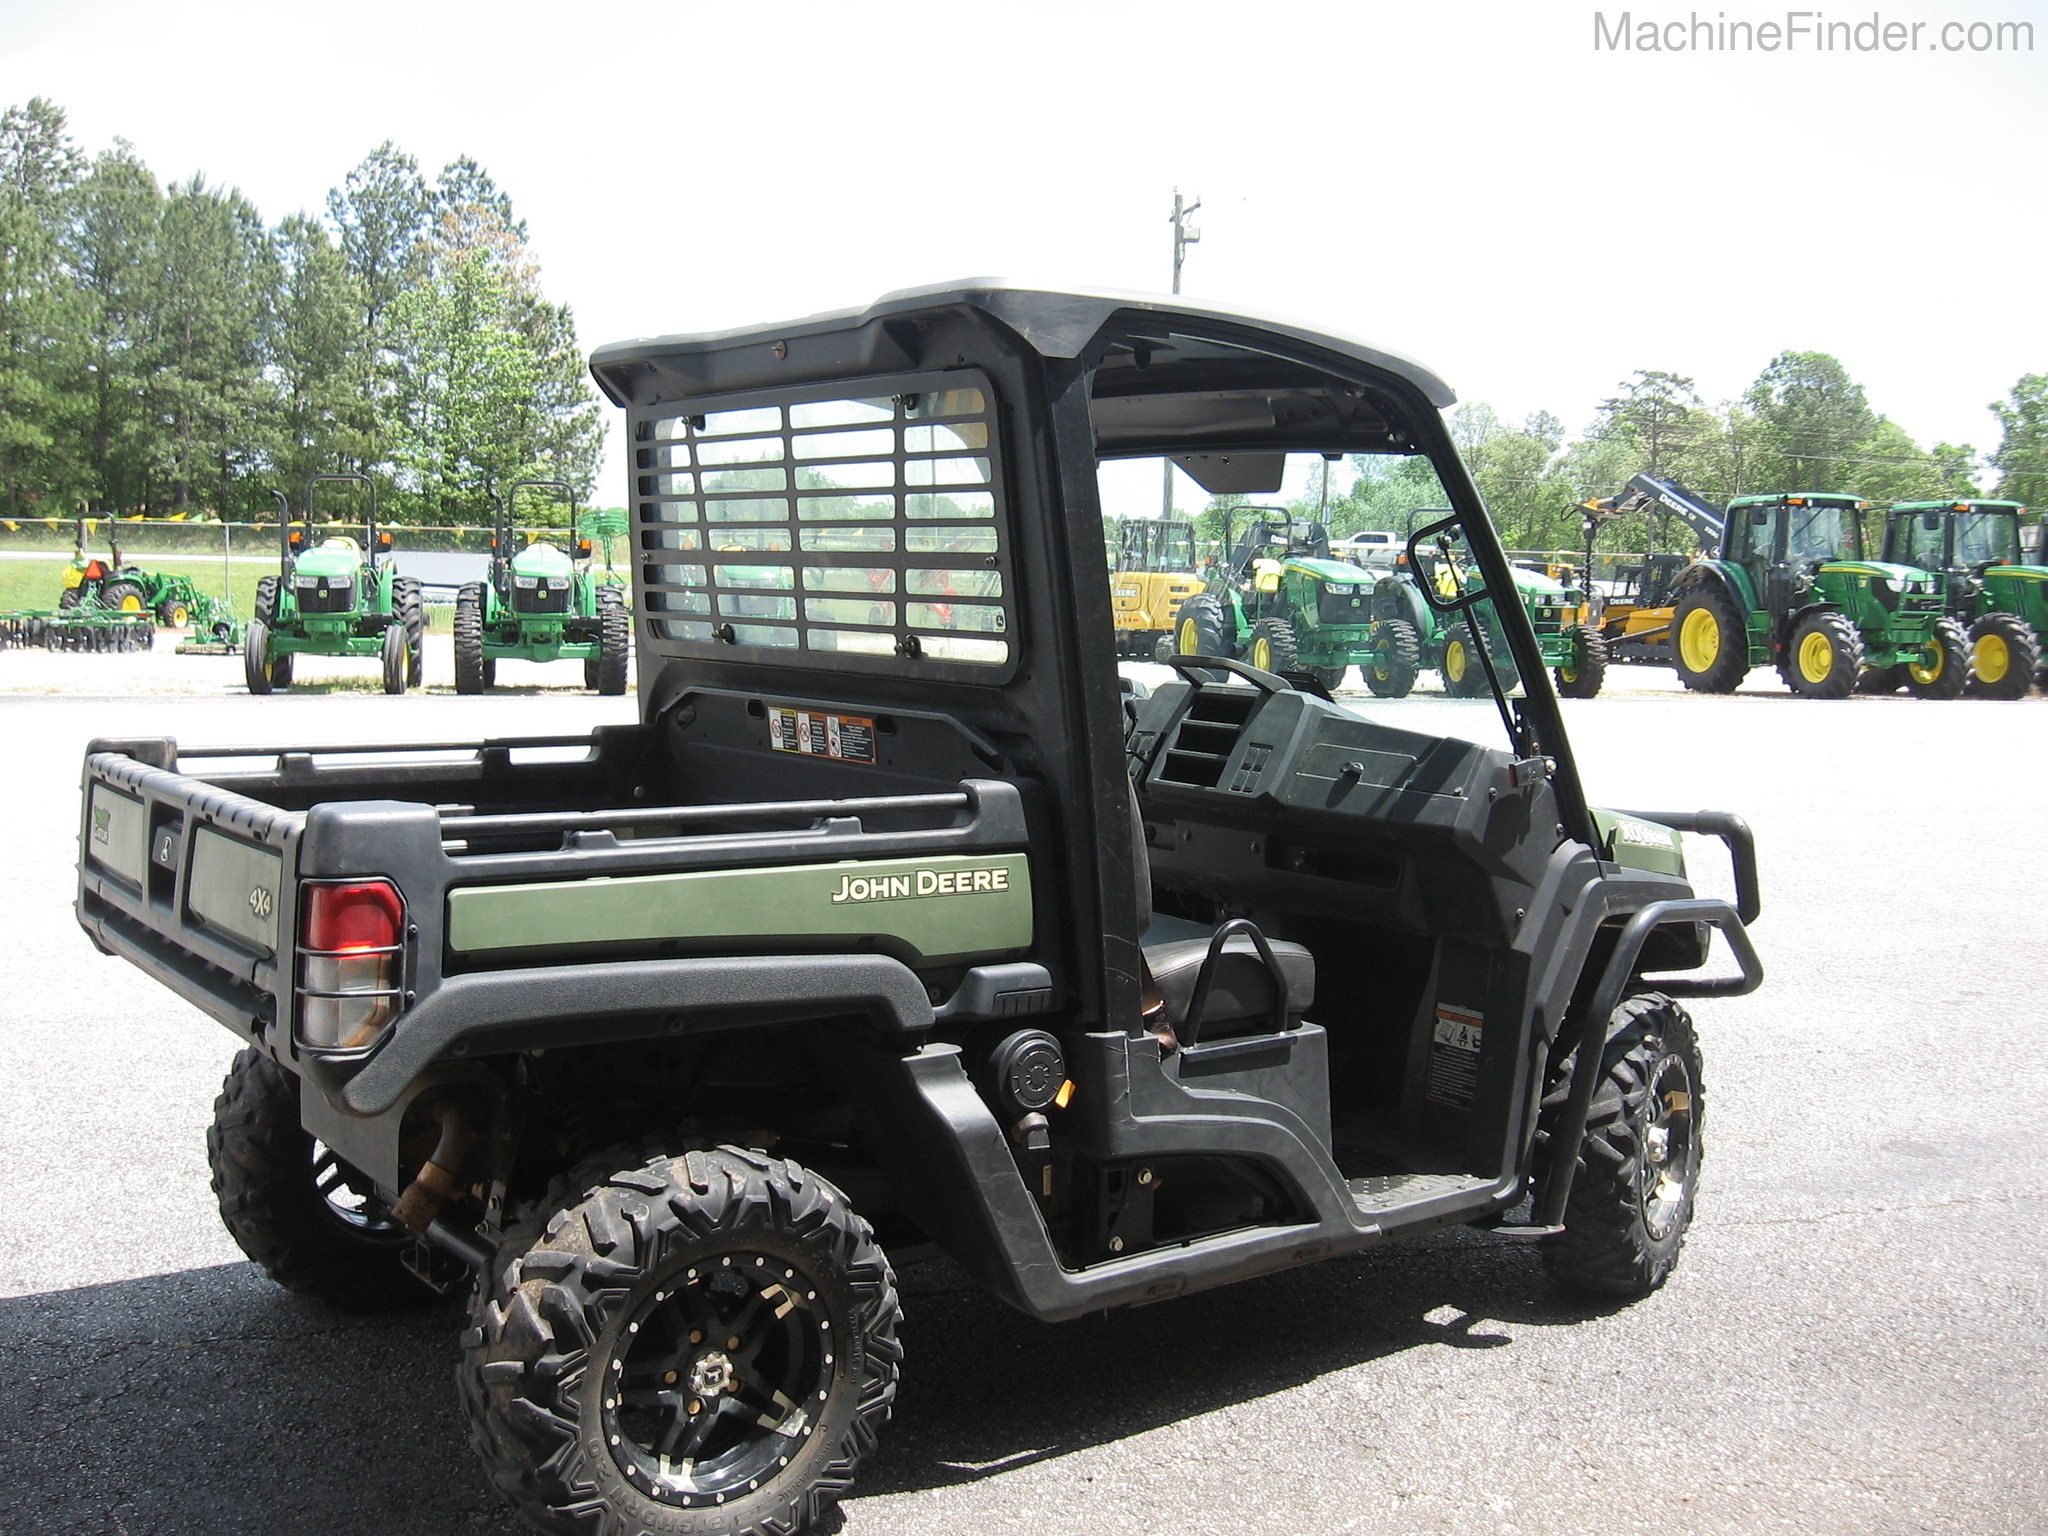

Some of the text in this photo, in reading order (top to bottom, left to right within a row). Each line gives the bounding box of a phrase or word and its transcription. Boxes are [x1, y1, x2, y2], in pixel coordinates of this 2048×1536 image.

[1658, 493, 1689, 516] DEERE
[831, 868, 1010, 904] JOHN DEERE
